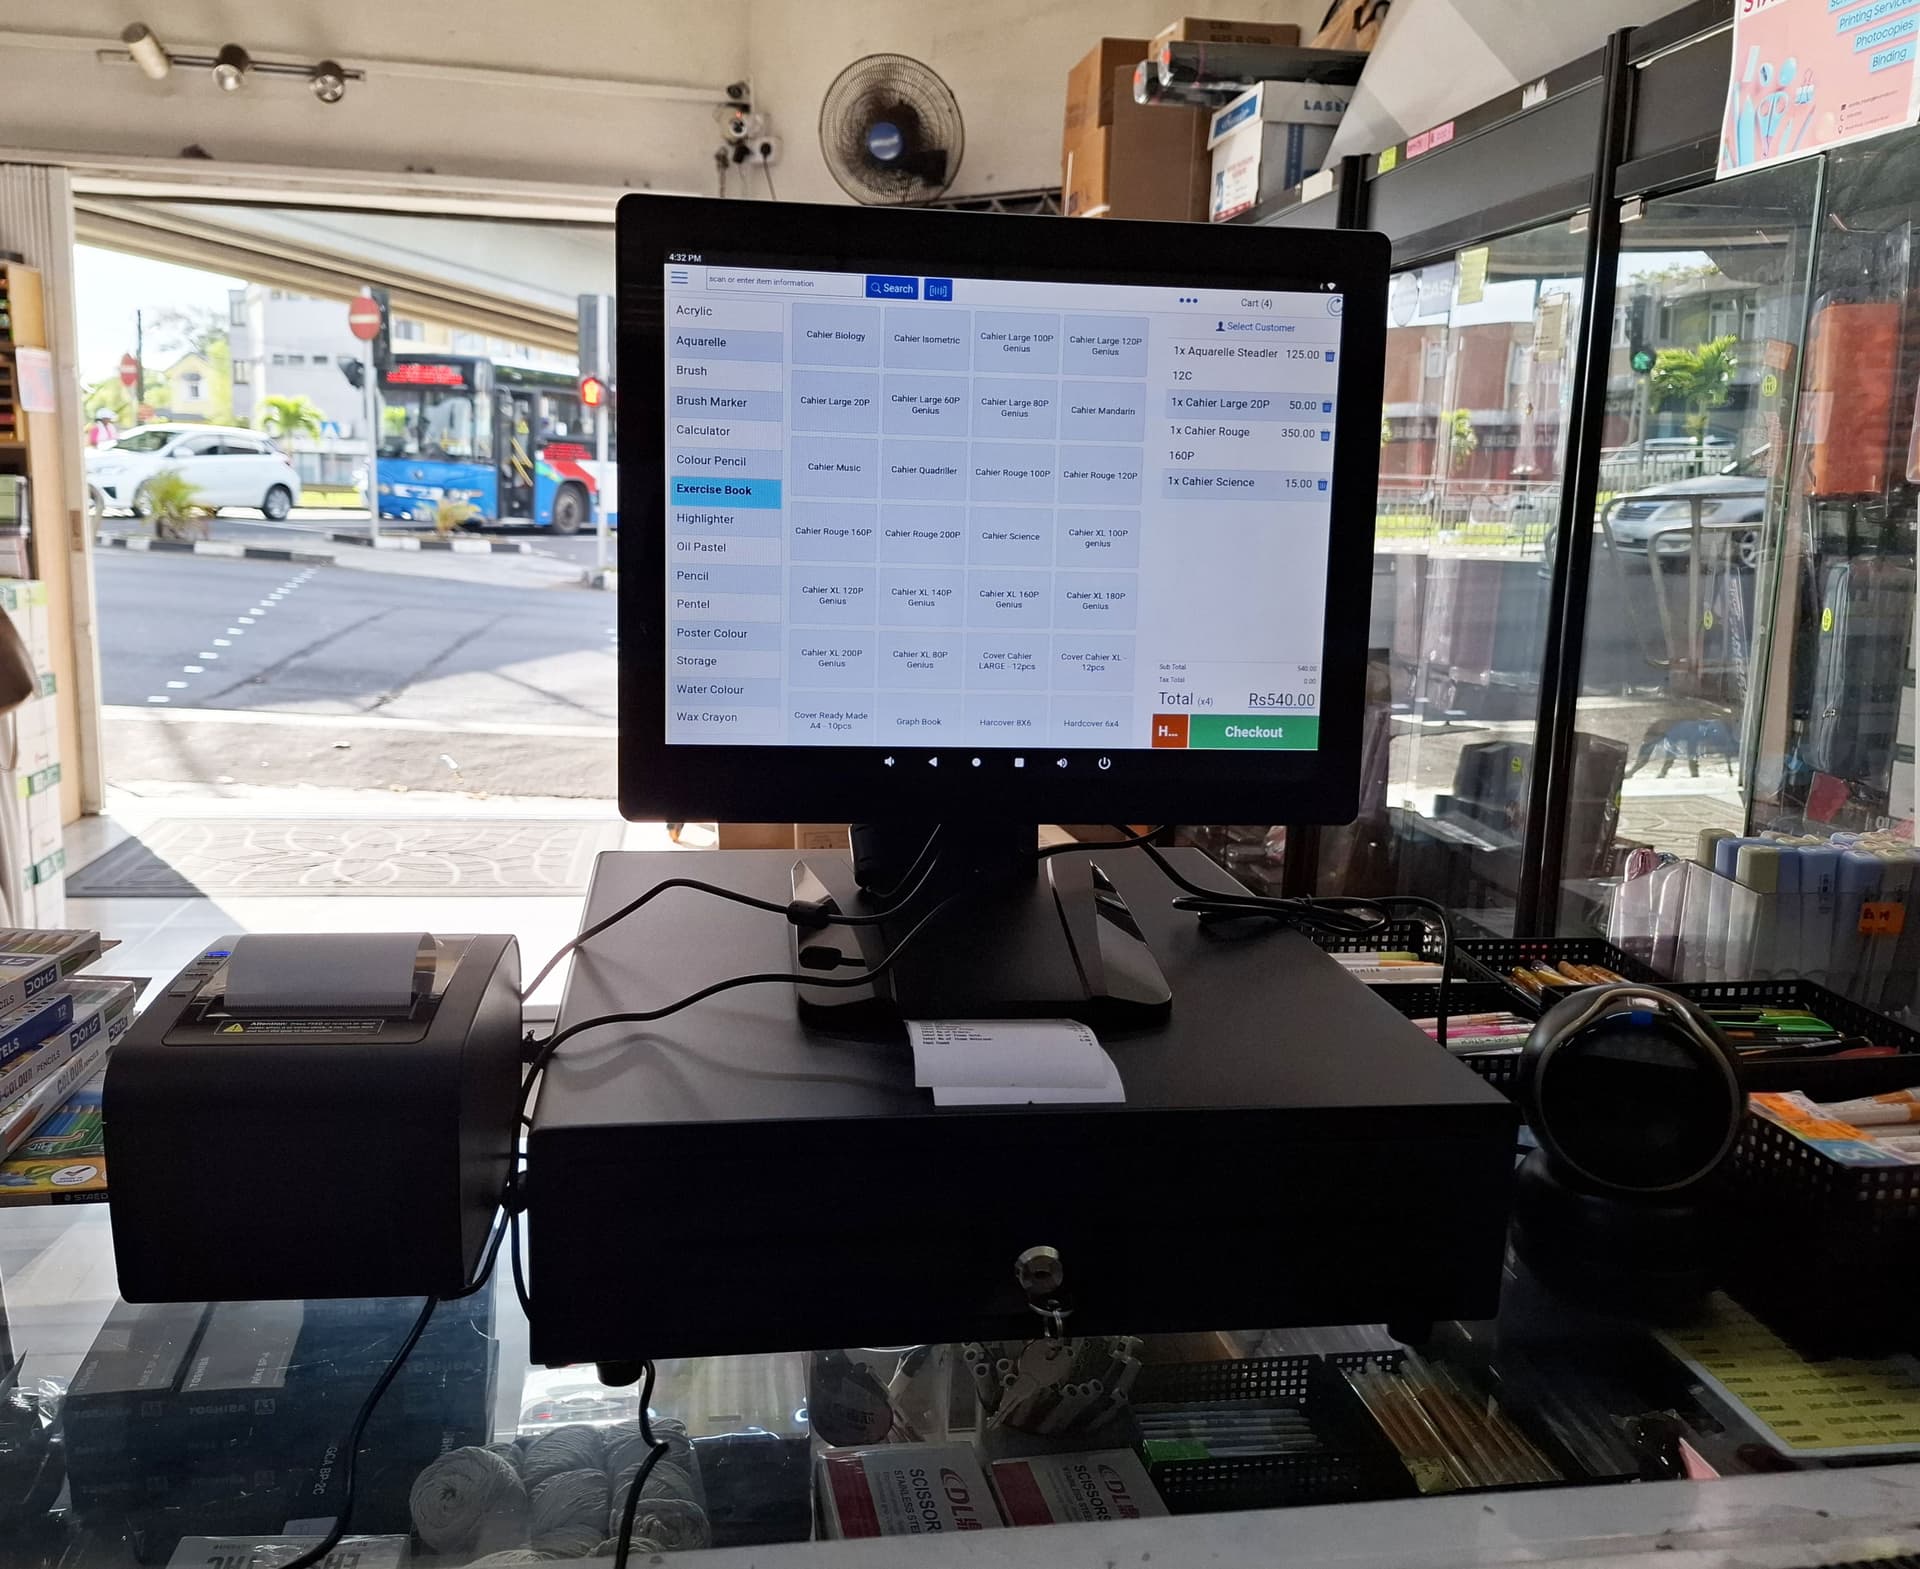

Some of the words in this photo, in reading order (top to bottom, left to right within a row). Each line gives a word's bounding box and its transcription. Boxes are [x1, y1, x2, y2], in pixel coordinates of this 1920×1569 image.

[1840, 9, 1873, 30] Printing
[1856, 20, 1914, 48] Photocopies
[1872, 48, 1907, 67] Binding
[669, 253, 687, 262] 4:32
[688, 254, 702, 262] PM
[709, 276, 727, 284] scan
[736, 277, 756, 285] enter
[756, 278, 773, 286] item
[773, 277, 815, 287] information
[883, 283, 914, 295] Search
[1240, 298, 1260, 308] Cart
[1260, 298, 1273, 310] (4)
[675, 305, 713, 318] Acrylic
[1227, 321, 1254, 332] Select
[1254, 322, 1296, 333] Customer
[675, 335, 727, 349] Aquarelle
[806, 330, 834, 339] Cahier
[835, 330, 866, 343] Biology
[894, 334, 921, 343] Cahier
[922, 335, 961, 345] Isometric
[980, 332, 1007, 341] Cahier
[1008, 333, 1032, 344] Large
[1033, 334, 1054, 343] 100P
[1069, 335, 1096, 344] Cahier
[1096, 336, 1120, 347] Large
[1122, 337, 1143, 346] 120P
[1002, 344, 1031, 353] Genius
[1091, 347, 1120, 356] Genius
[1174, 346, 1186, 356] 1x
[1187, 346, 1236, 359] Aquarelle
[1237, 347, 1279, 358] Steadler
[1286, 349, 1320, 360] 125.00
[676, 365, 708, 376] Brush
[1172, 370, 1193, 381] 12C
[676, 395, 708, 406] Brush
[710, 396, 748, 408] Marker
[800, 396, 828, 405] Cahier
[828, 397, 852, 408] Large
[853, 398, 871, 407] 20P
[891, 394, 918, 403] Cahier
[919, 396, 943, 406] Large
[944, 396, 961, 405] 60P
[1171, 397, 1184, 408] 1x
[1185, 397, 1218, 408] Cahier
[1220, 399, 1248, 411] Large
[1250, 399, 1270, 409] 20P
[1289, 400, 1317, 411] 50.00
[911, 406, 940, 415] Genius
[1071, 406, 1097, 415] Cahier
[1098, 406, 1136, 416] Mandarin
[676, 424, 731, 436] Calculator
[1170, 425, 1182, 435] 1x
[1183, 425, 1217, 436] Cahier
[1218, 426, 1250, 439] Rouge
[1281, 428, 1316, 439] 350.00
[676, 454, 712, 465] Colour
[714, 455, 747, 466] Pencil
[1169, 450, 1196, 461] 160P
[807, 462, 834, 471] Cahier
[836, 463, 862, 472] Music
[891, 465, 918, 474] Cahier
[918, 466, 958, 476] Quadriller
[975, 468, 1002, 476] Cahier
[1002, 469, 1029, 479] Rouge
[1030, 469, 1051, 478] 100P
[1168, 476, 1180, 486] 1x
[1181, 476, 1214, 487] Cahier
[1215, 477, 1255, 487] Science
[1285, 478, 1313, 489] 15.00
[676, 483, 722, 495] Exercise
[724, 485, 752, 496] Book
[676, 513, 735, 526] Highlighter
[981, 531, 1008, 540] Cahier
[1008, 532, 1041, 541] Science
[1068, 528, 1094, 537] Cahier
[1095, 529, 1106, 537] XL
[1108, 529, 1129, 538] 100P
[676, 541, 691, 551] Oil
[693, 542, 726, 553] Pastel
[1084, 539, 1112, 550] genius
[676, 570, 709, 581] Pencil
[801, 585, 828, 594] Cahier
[829, 586, 841, 594] XL
[843, 586, 864, 595] 120P
[677, 599, 710, 609] Pentel
[818, 597, 847, 605] Genius
[676, 627, 712, 638] Poster
[713, 628, 748, 639] Colour
[801, 648, 828, 657] Cahier
[828, 649, 840, 657] XL
[841, 649, 863, 657] 200P
[982, 652, 1006, 660] Cover
[1007, 652, 1033, 660] Cahier
[1060, 653, 1084, 661] Cover
[1085, 653, 1110, 661] Cahier
[1111, 653, 1122, 662] XL
[676, 655, 718, 668] Storage
[817, 659, 846, 668] Genius
[978, 662, 1006, 670] LARGE
[1013, 663, 1036, 672] 12pcs
[1082, 663, 1105, 673] 12pcs
[676, 684, 708, 694] Water
[709, 685, 744, 695] Colour
[1158, 691, 1194, 705] Total
[1197, 697, 1214, 706] (x4)
[1248, 692, 1316, 707] Rs540.00
[676, 711, 700, 722] Wax
[701, 712, 738, 724] Crayon
[794, 711, 818, 719] Cover
[818, 711, 844, 722] Ready
[845, 711, 869, 720] Made
[896, 717, 920, 727] Graph
[921, 717, 942, 726] Book
[828, 722, 852, 732] 10pcs
[979, 719, 1015, 727] Harcover
[1016, 719, 1032, 727] 8X6
[1063, 719, 1104, 728] Hardcover
[1104, 720, 1120, 728] 6x4
[1224, 725, 1284, 738] Checkout
[909, 1468, 943, 1533] SCISSOR
